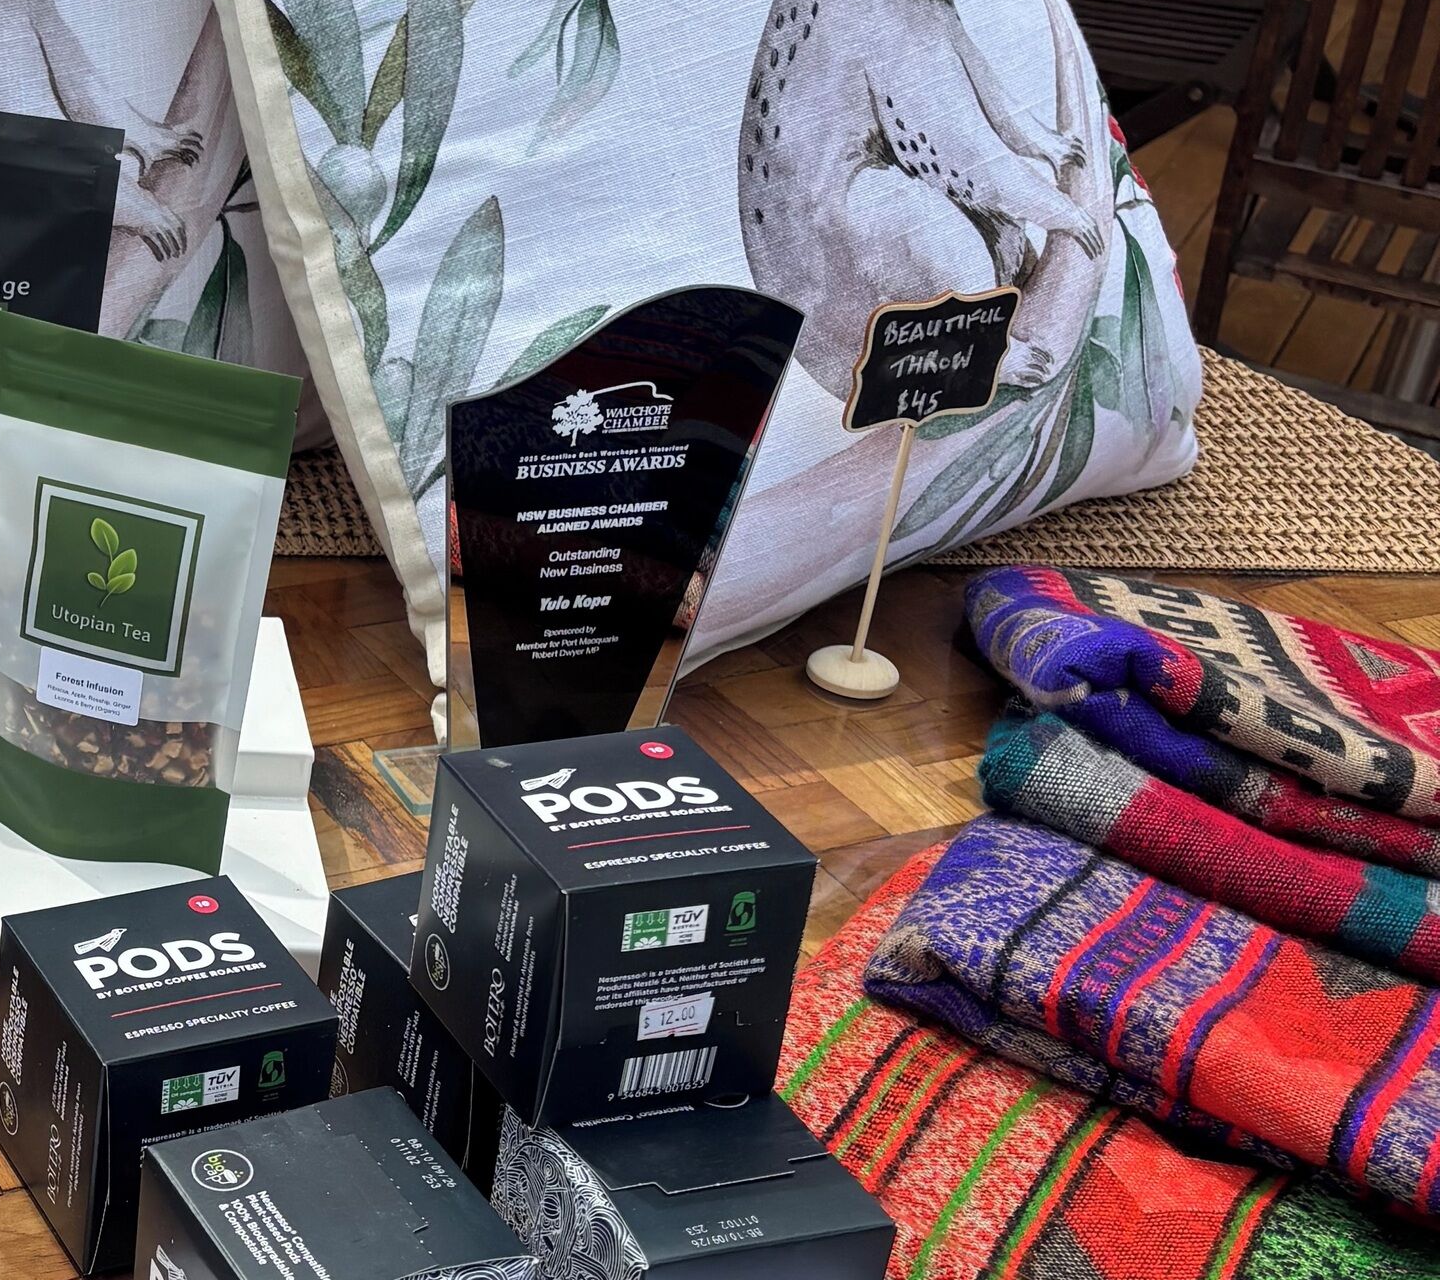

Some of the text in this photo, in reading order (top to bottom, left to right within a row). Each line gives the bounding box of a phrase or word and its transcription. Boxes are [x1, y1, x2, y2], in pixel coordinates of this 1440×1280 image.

[884, 306, 1005, 346] BEAUTIFUL
[890, 344, 974, 378] THROW
[606, 404, 672, 418] WAUCHOPE
[897, 389, 943, 417] $45
[602, 416, 669, 428] CHAMBER
[515, 454, 686, 480] BUSINESS AWARDS
[517, 501, 668, 522] NSW BUSINESS CHAMBER
[537, 516, 643, 534] ALIGNED AWARDS
[549, 547, 621, 562] Outstanding
[570, 563, 623, 576] Business
[573, 594, 611, 609] Kopa
[52, 604, 150, 642] Utopian Tea
[585, 626, 596, 634] by
[516, 642, 548, 651] Member
[549, 640, 560, 648] for
[561, 639, 578, 647] Port
[532, 650, 558, 659] Robert
[559, 649, 585, 657] Dwyer
[56, 672, 124, 696] Forest Infusion
[647, 745, 665, 754] 10
[520, 776, 719, 824] PODS
[549, 805, 733, 832] BY BOTERO COFFEE ROASTERS
[584, 842, 770, 869] ESPRESSO SPECIALITY COFFEE
[195, 899, 210, 910] 10
[74, 932, 255, 991] PODS
[96, 962, 267, 999] BY BOTERO COFFEE ROASTERS
[124, 1001, 298, 1039] ESPRESSO SPECIALITY COFFEE
[483, 967, 505, 1057] BOTERO
[202, 1162, 223, 1184] cap
[207, 1154, 224, 1173] bio
[390, 1138, 441, 1189] 011102 253
[230, 1199, 253, 1222] 100%
[218, 1203, 267, 1265] & Compostable
[245, 1194, 301, 1264] Plant-based Pods
